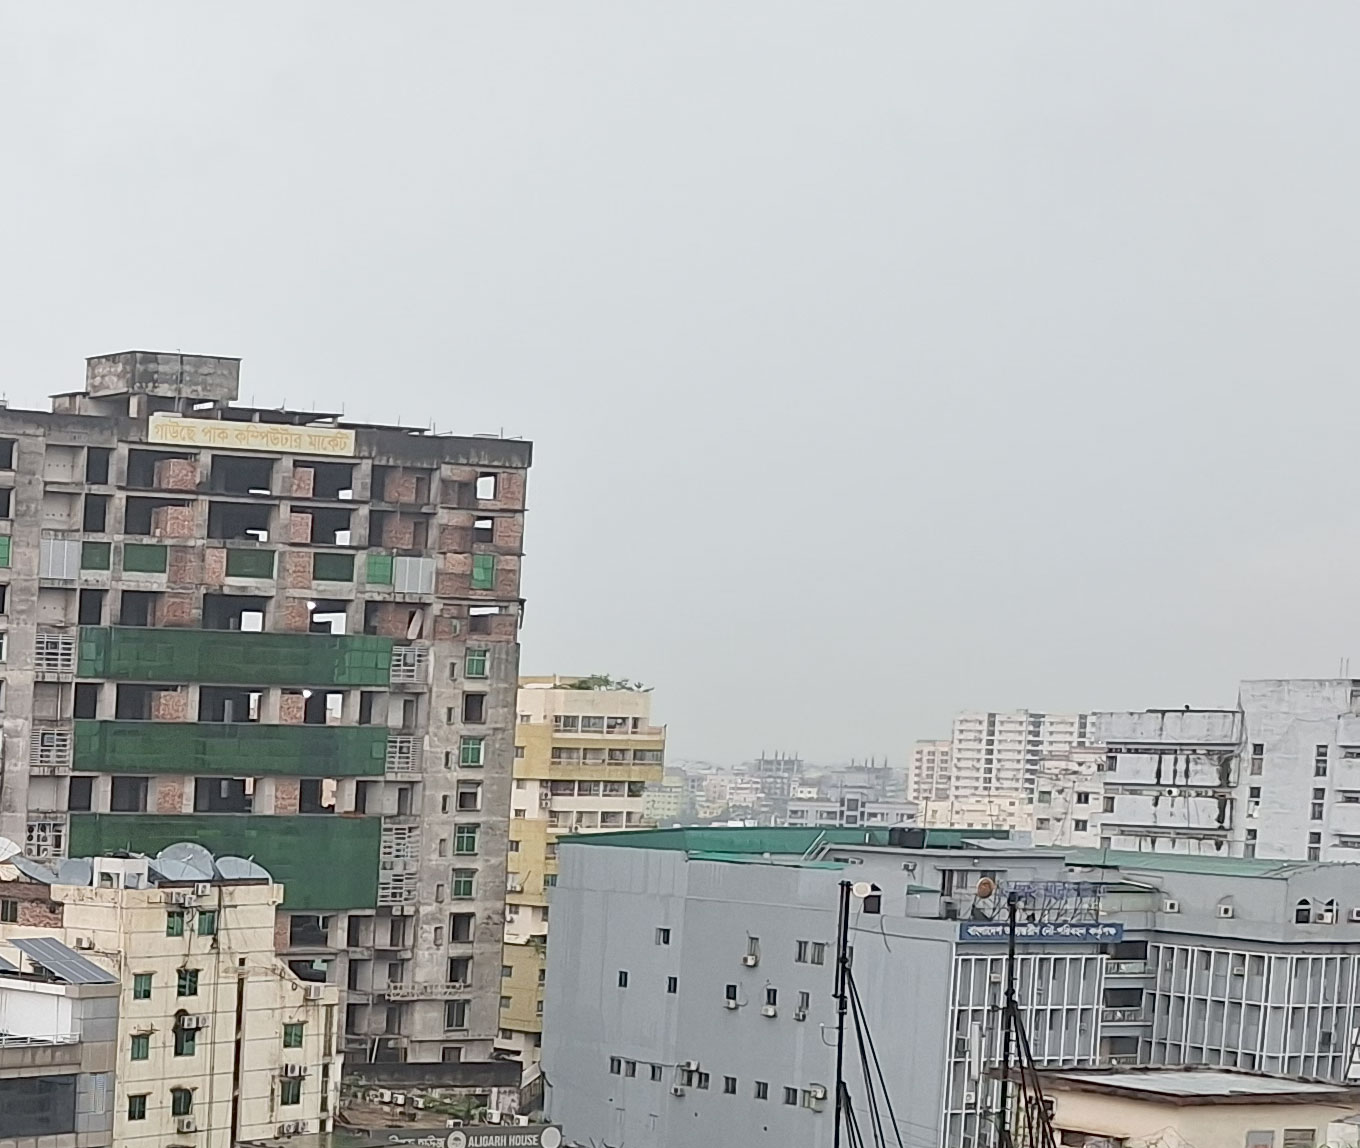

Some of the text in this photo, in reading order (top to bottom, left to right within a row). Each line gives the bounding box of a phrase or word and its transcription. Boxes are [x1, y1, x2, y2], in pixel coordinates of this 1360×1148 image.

[201, 425, 231, 444] পাক
[468, 1134, 539, 1148] ALIGARH HOUSE
